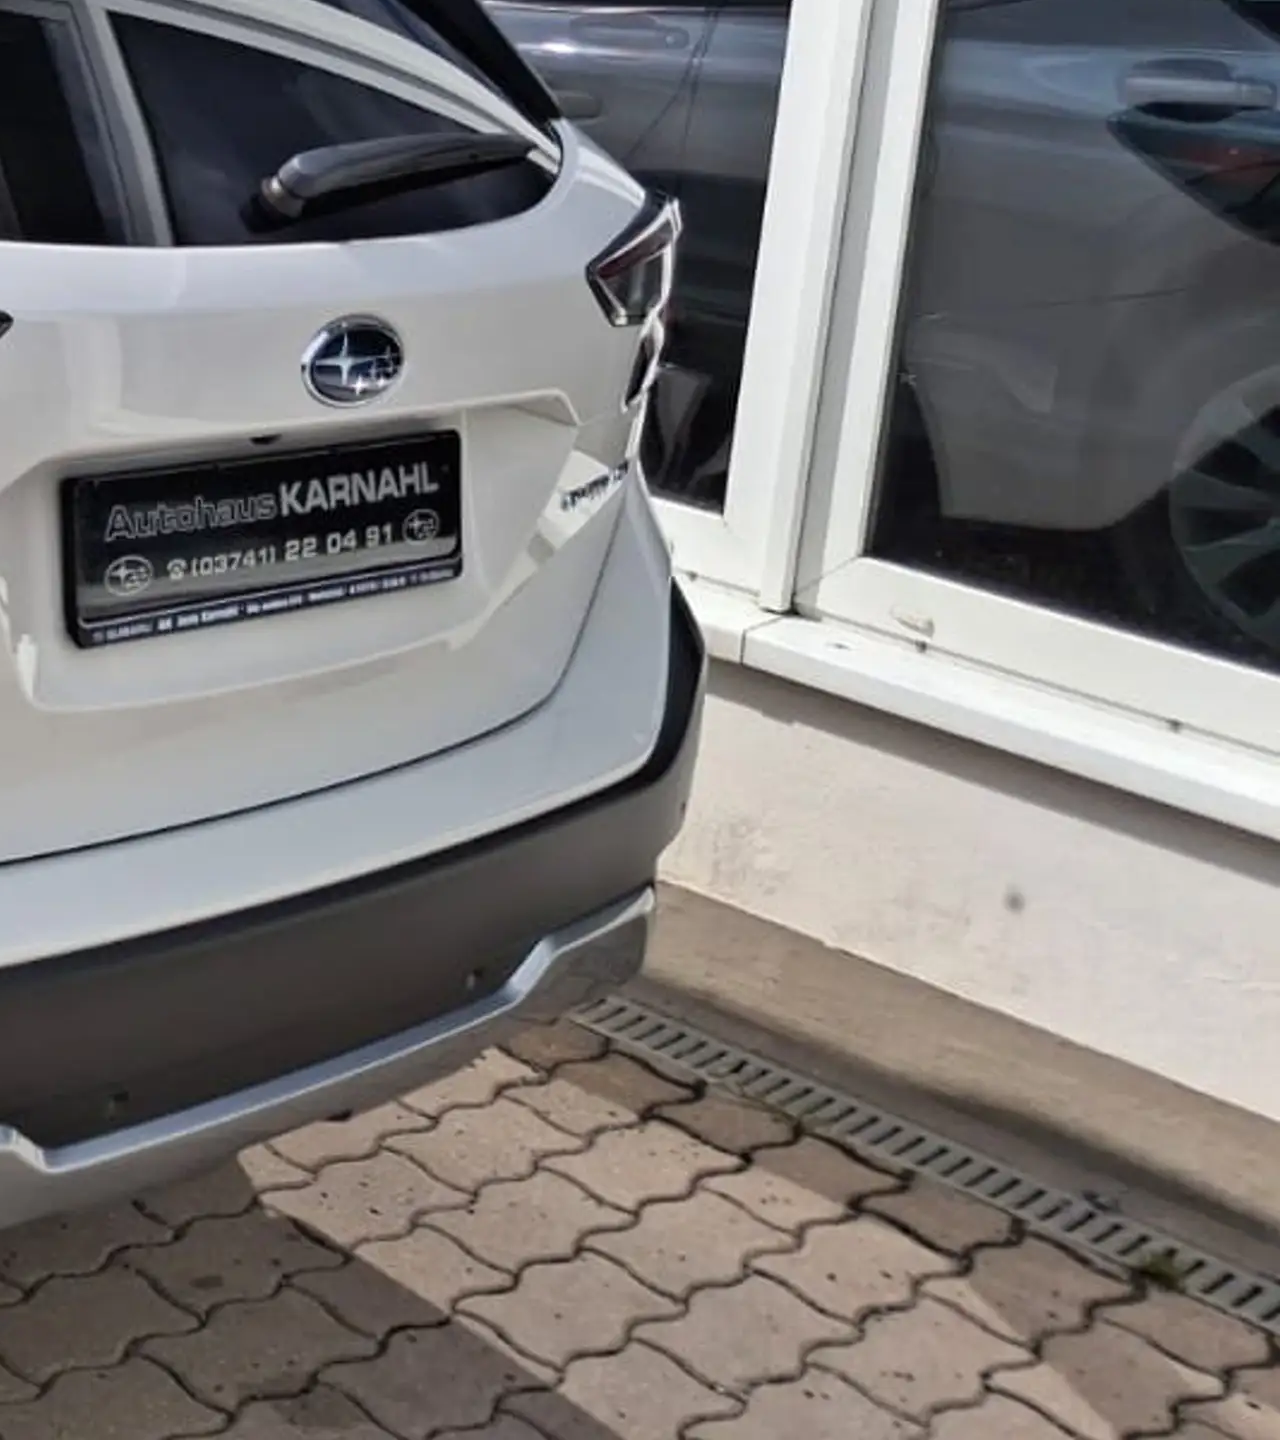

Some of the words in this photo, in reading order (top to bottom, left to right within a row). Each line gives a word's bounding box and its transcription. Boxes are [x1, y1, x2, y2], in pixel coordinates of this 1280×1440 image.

[104, 491, 278, 543] Autohaus
[279, 462, 439, 515] KARNAHL
[284, 535, 318, 561] 22
[326, 529, 358, 554] 04
[365, 522, 394, 547] 91
